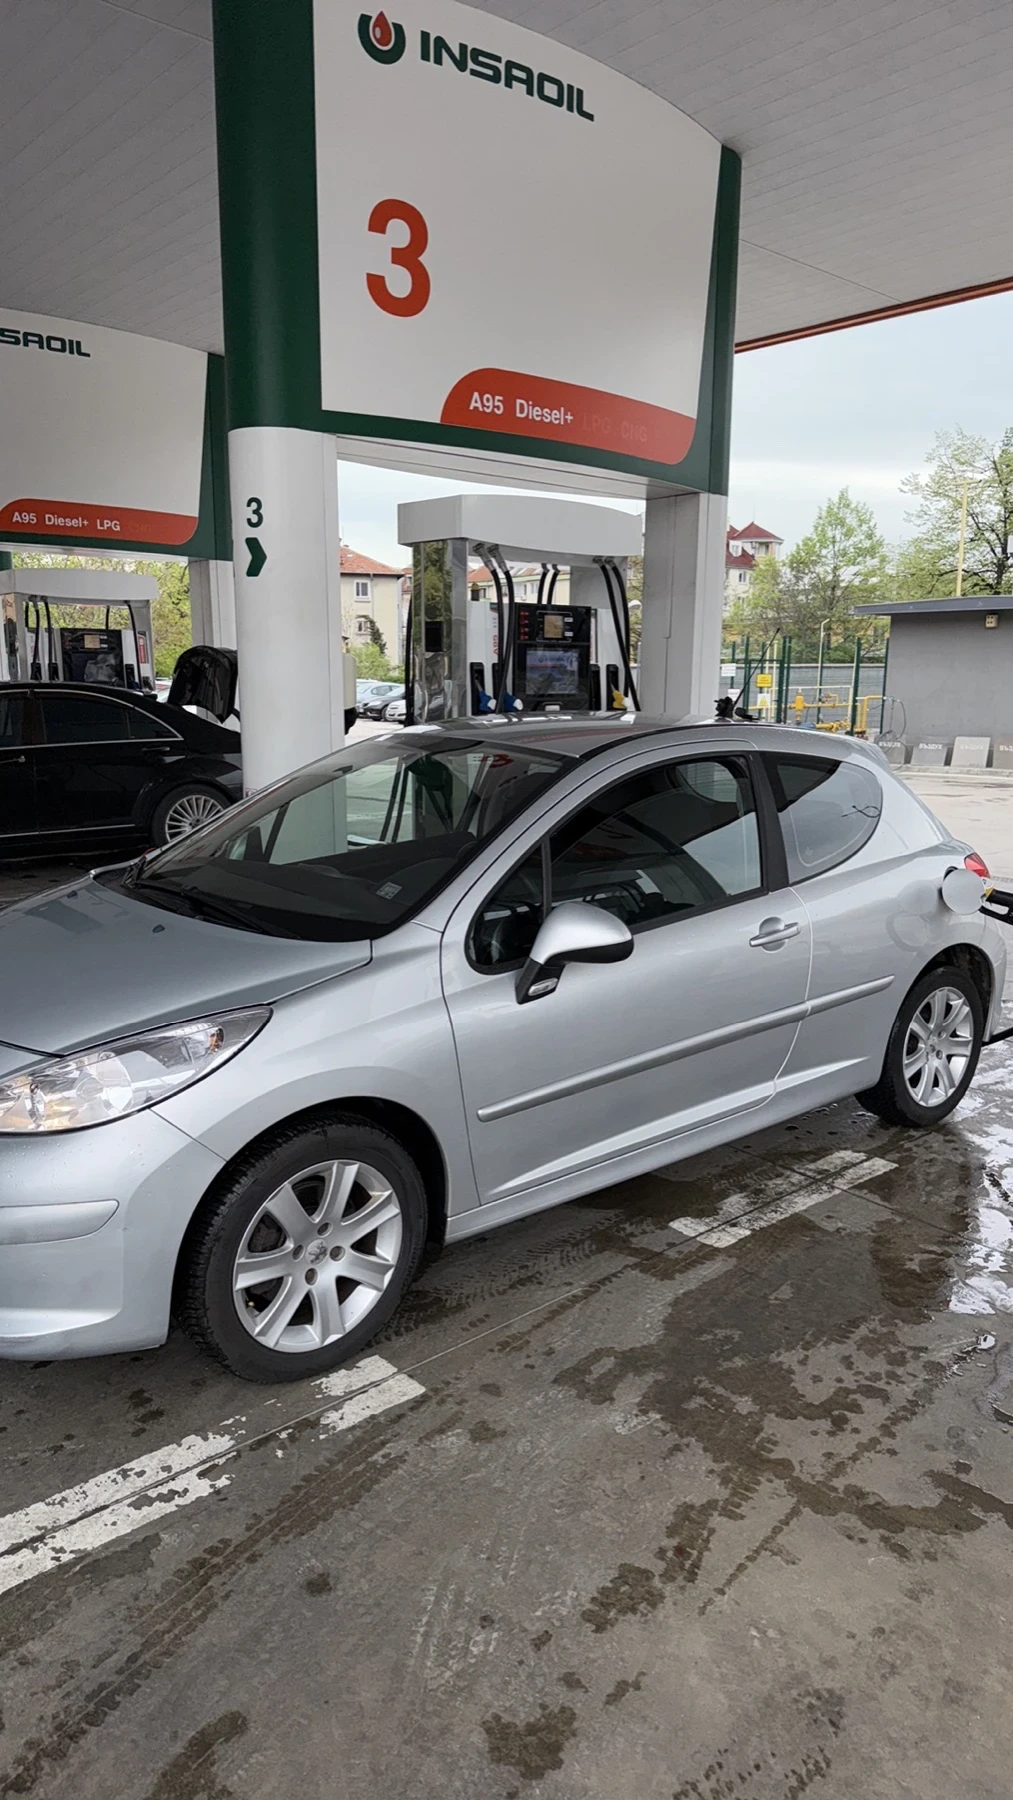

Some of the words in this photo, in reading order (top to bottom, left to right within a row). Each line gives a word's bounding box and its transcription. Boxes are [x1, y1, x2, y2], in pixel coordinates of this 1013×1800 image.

[420, 30, 595, 122] INSAOIL
[366, 198, 431, 318] 3
[469, 391, 504, 415] A95
[515, 399, 574, 426] Diesel+
[12, 511, 37, 525] A95
[45, 514, 89, 529] Diesel+
[96, 518, 121, 532] LPG
[246, 497, 264, 529] 3
